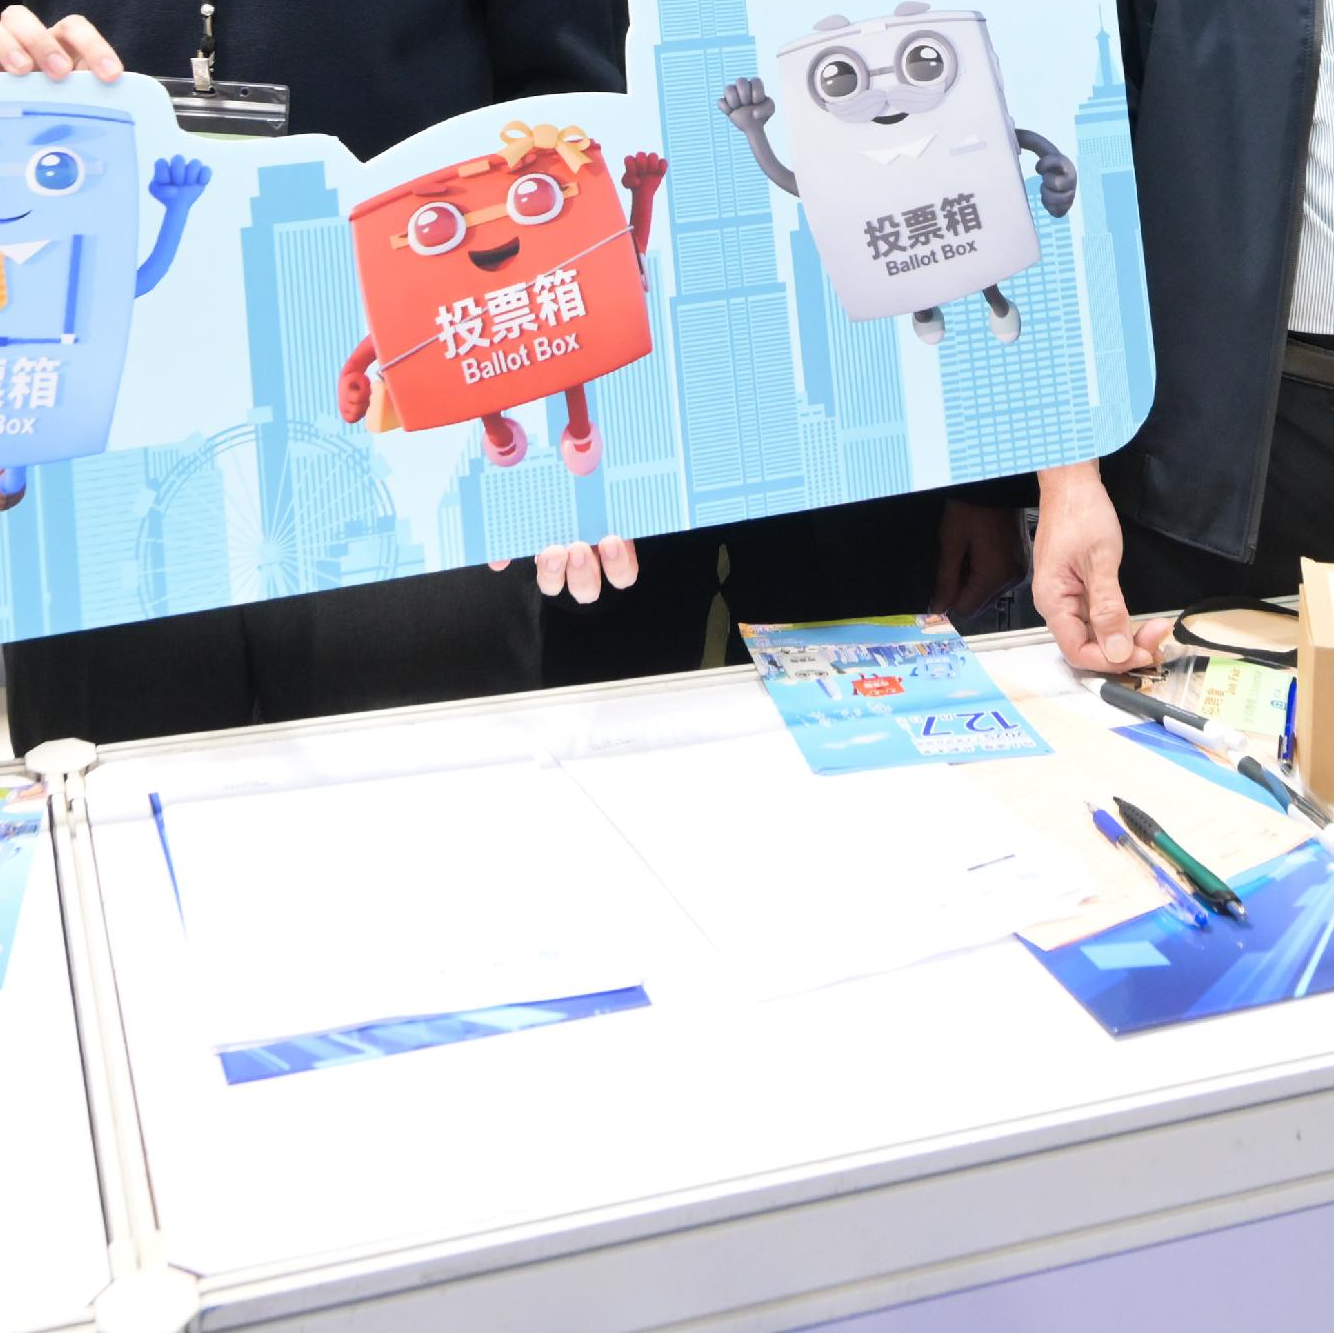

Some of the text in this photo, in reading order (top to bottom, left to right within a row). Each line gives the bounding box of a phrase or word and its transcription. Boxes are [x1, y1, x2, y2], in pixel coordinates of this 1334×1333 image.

[864, 193, 982, 260] 投票箱
[886, 240, 977, 276] Ballot Box
[435, 268, 586, 359] 投票箱
[461, 332, 580, 386] Ballot Box
